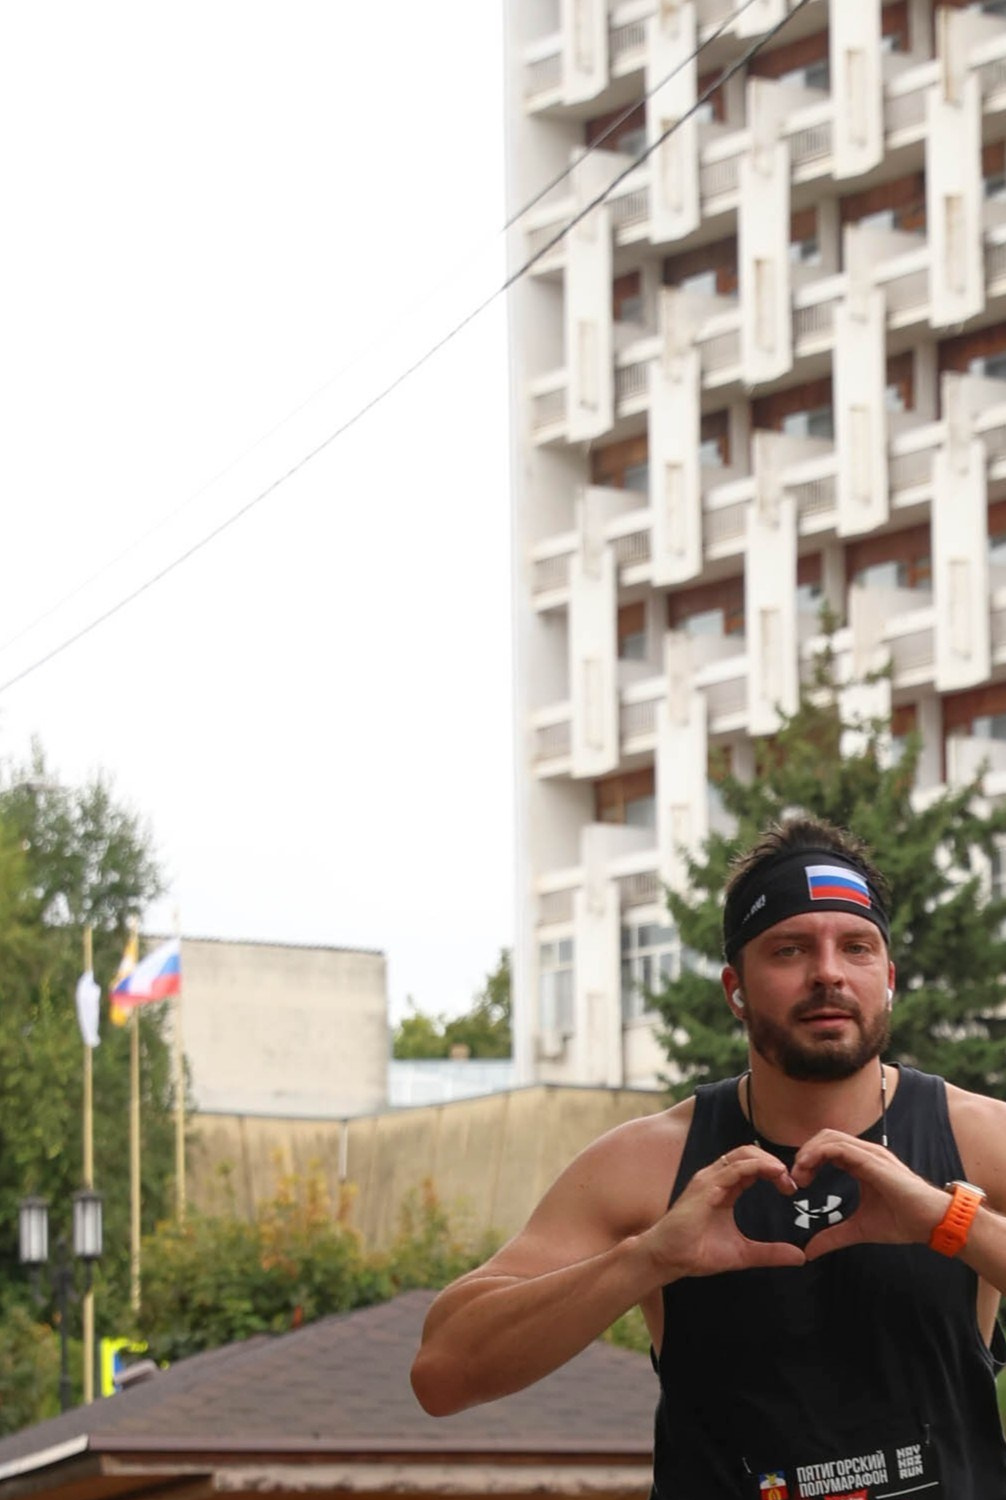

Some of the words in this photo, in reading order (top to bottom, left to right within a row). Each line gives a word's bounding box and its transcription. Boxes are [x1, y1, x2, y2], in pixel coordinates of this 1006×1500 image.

[796, 1450, 887, 1483] ПЯТИГОРСКИЙ
[900, 1464, 924, 1479] RUN
[799, 1469, 889, 1498] ПОЛУМАРАФОН
